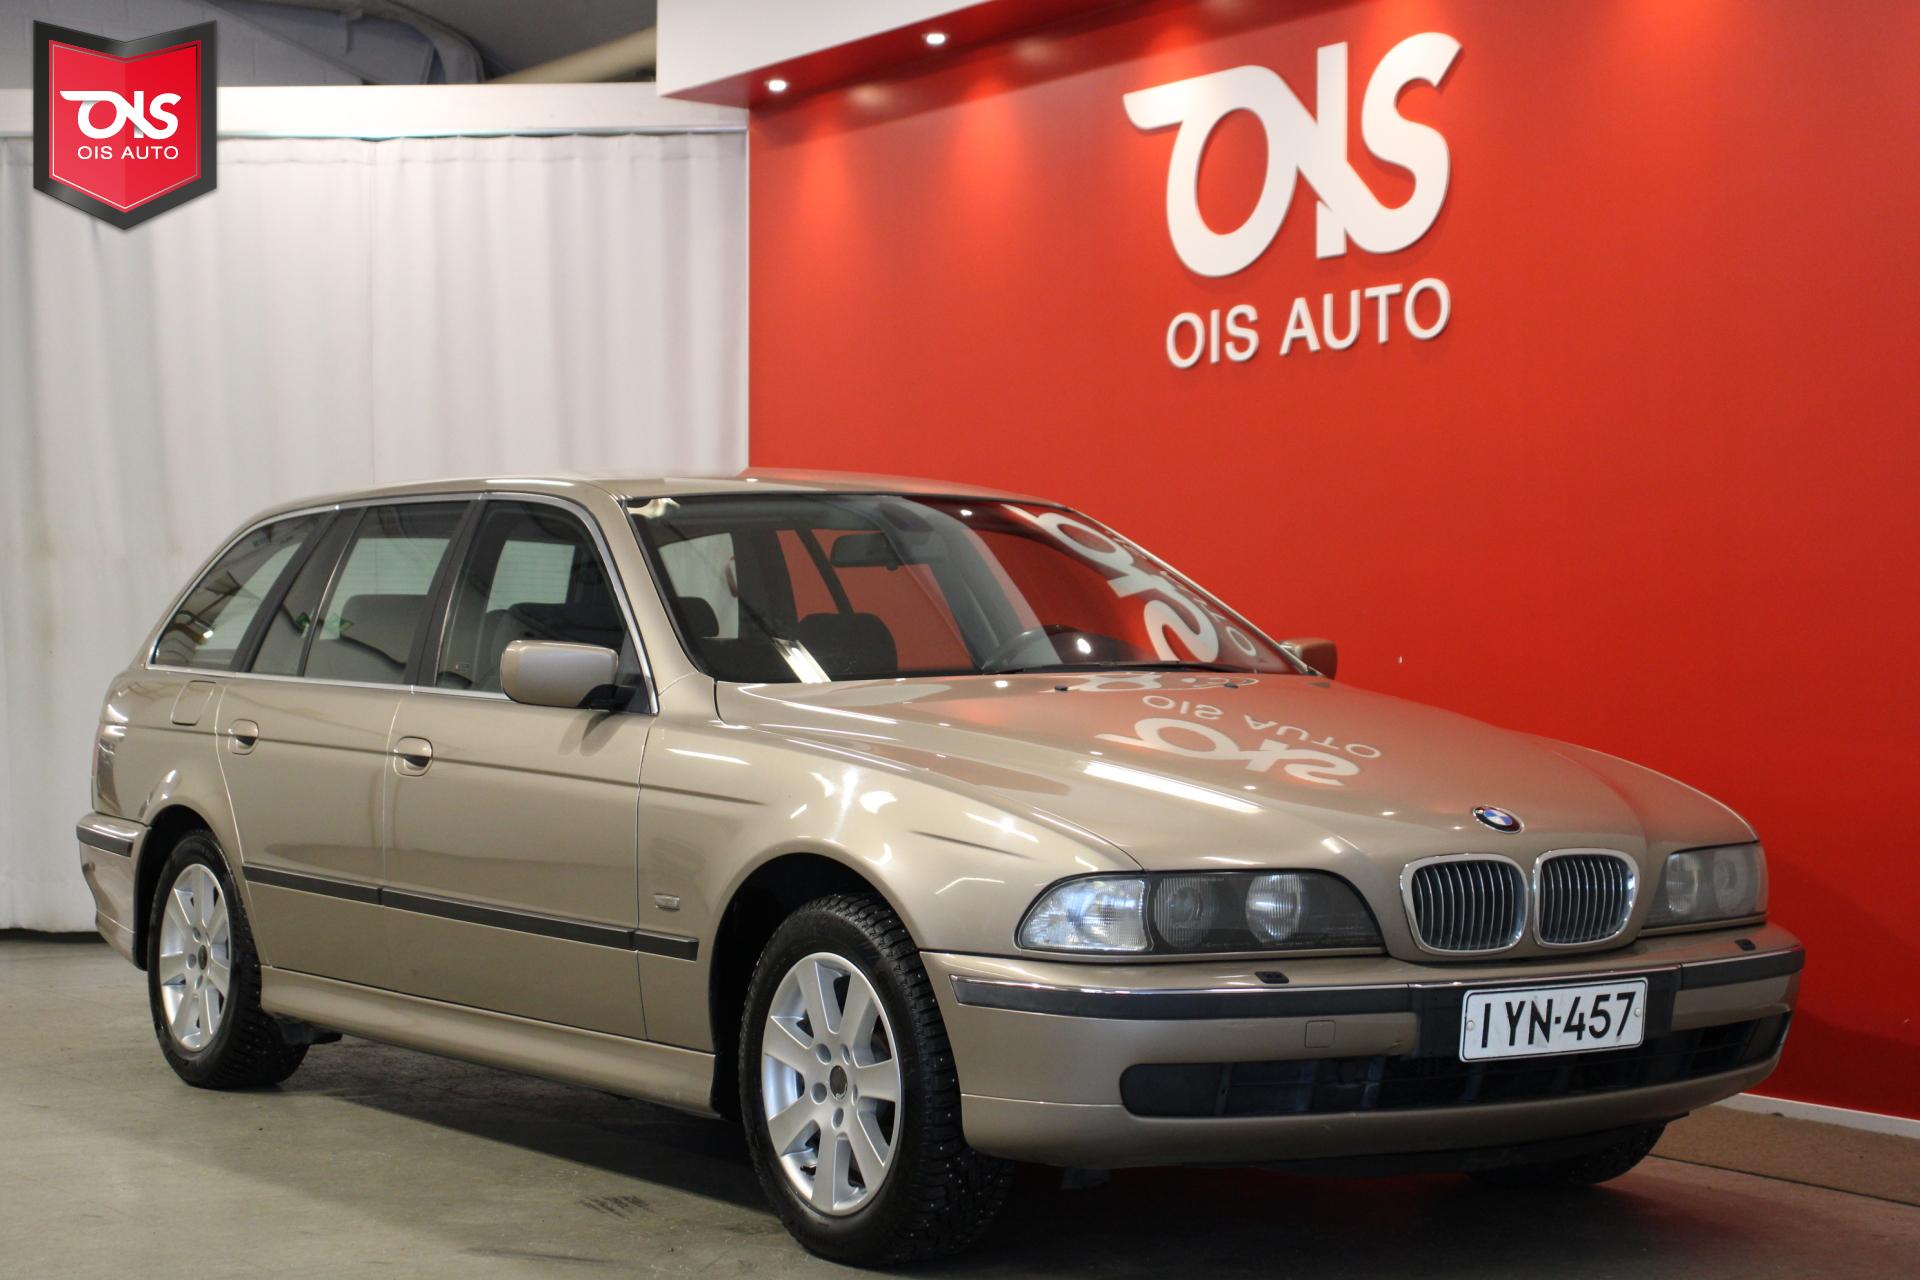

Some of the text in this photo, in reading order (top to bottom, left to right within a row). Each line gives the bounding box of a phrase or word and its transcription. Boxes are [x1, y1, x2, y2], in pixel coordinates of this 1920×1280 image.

[1123, 31, 1462, 277] OIS
[1166, 278, 1451, 369] OIS AUTO
[1481, 991, 1636, 1048] IYN-457
